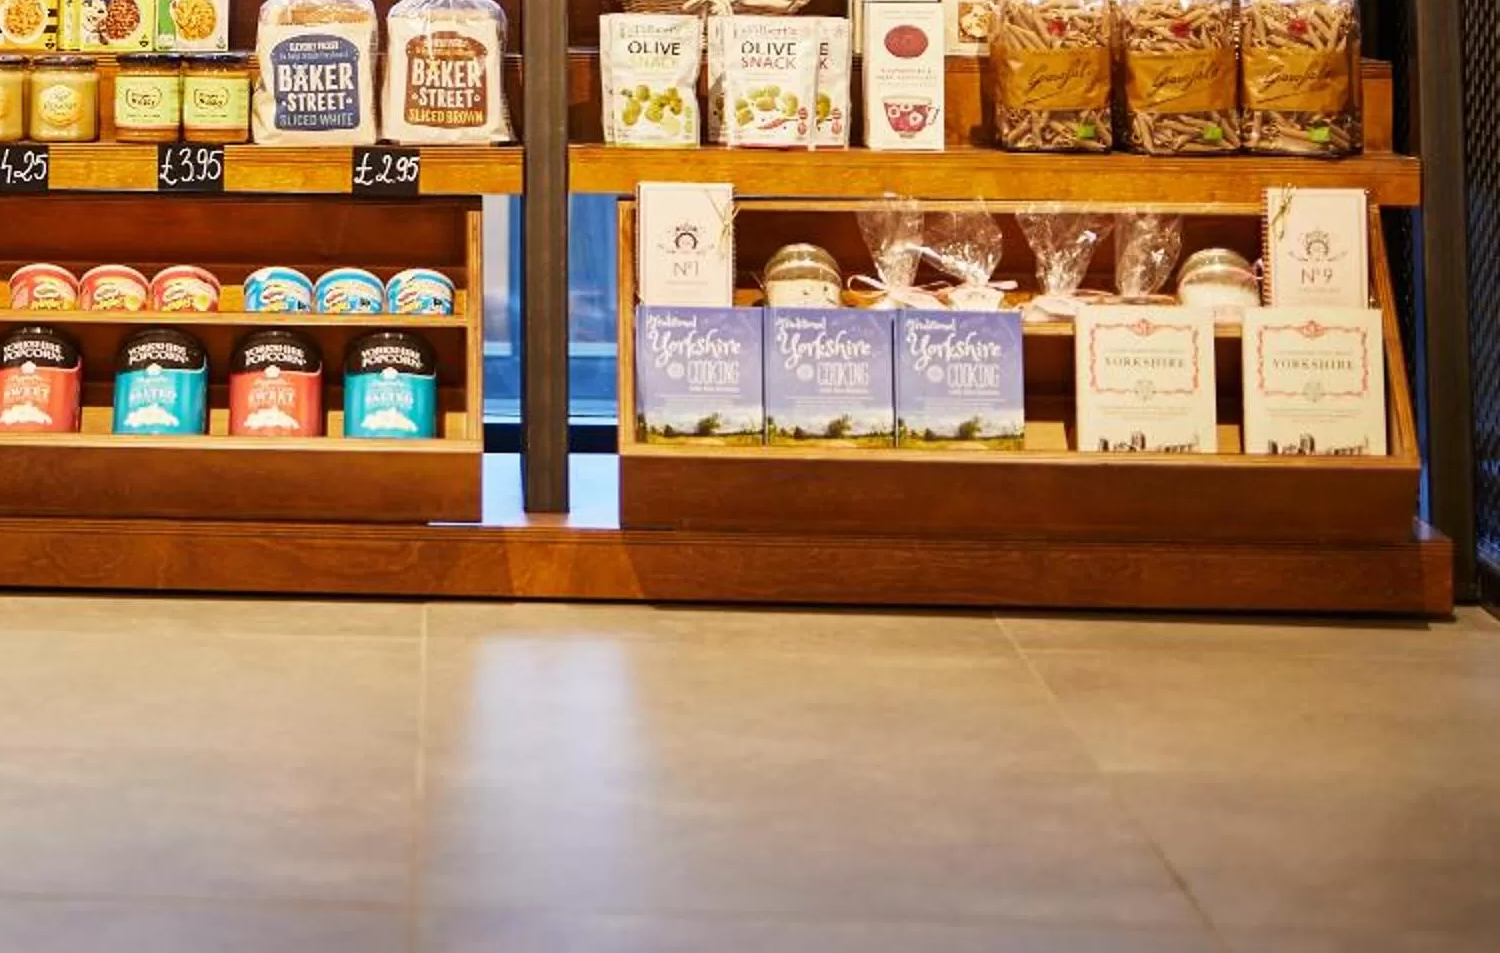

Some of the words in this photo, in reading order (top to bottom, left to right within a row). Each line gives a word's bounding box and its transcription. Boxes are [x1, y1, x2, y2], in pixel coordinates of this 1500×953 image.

[627, 40, 681, 56] OLIVE
[741, 41, 797, 56] OLIVE
[741, 57, 797, 70] SNACK
[278, 62, 354, 92] BAKER
[411, 58, 483, 88] BAKER
[287, 92, 347, 112] STREET
[418, 88, 475, 108] STREET
[279, 113, 317, 127] SLICED
[319, 112, 354, 126] WHITE
[408, 110, 446, 123] SLICED
[446, 110, 484, 123] BROWN
[160, 148, 222, 185] £3.95
[354, 153, 420, 185] £2.95
[3, 340, 62, 353] YORKSHIRE
[128, 342, 187, 356] YORKSHIRE
[245, 344, 305, 357] YORKSHIRE
[361, 346, 421, 359] YORKSHIRE
[648, 328, 741, 368] Yorkshire
[775, 329, 872, 369] Yorkshire
[905, 331, 1002, 372] Yorkshire
[3, 349, 65, 362] POPCORN
[128, 352, 189, 365] POPCORN
[245, 353, 307, 366] POPCORN
[361, 355, 424, 369] POPCORN
[1104, 357, 1185, 369] YORKSHIRE
[1271, 358, 1354, 370] YORKSHIRE
[687, 360, 740, 384] COOKING
[816, 361, 869, 386] COOKING
[946, 362, 1000, 388] COOKING
